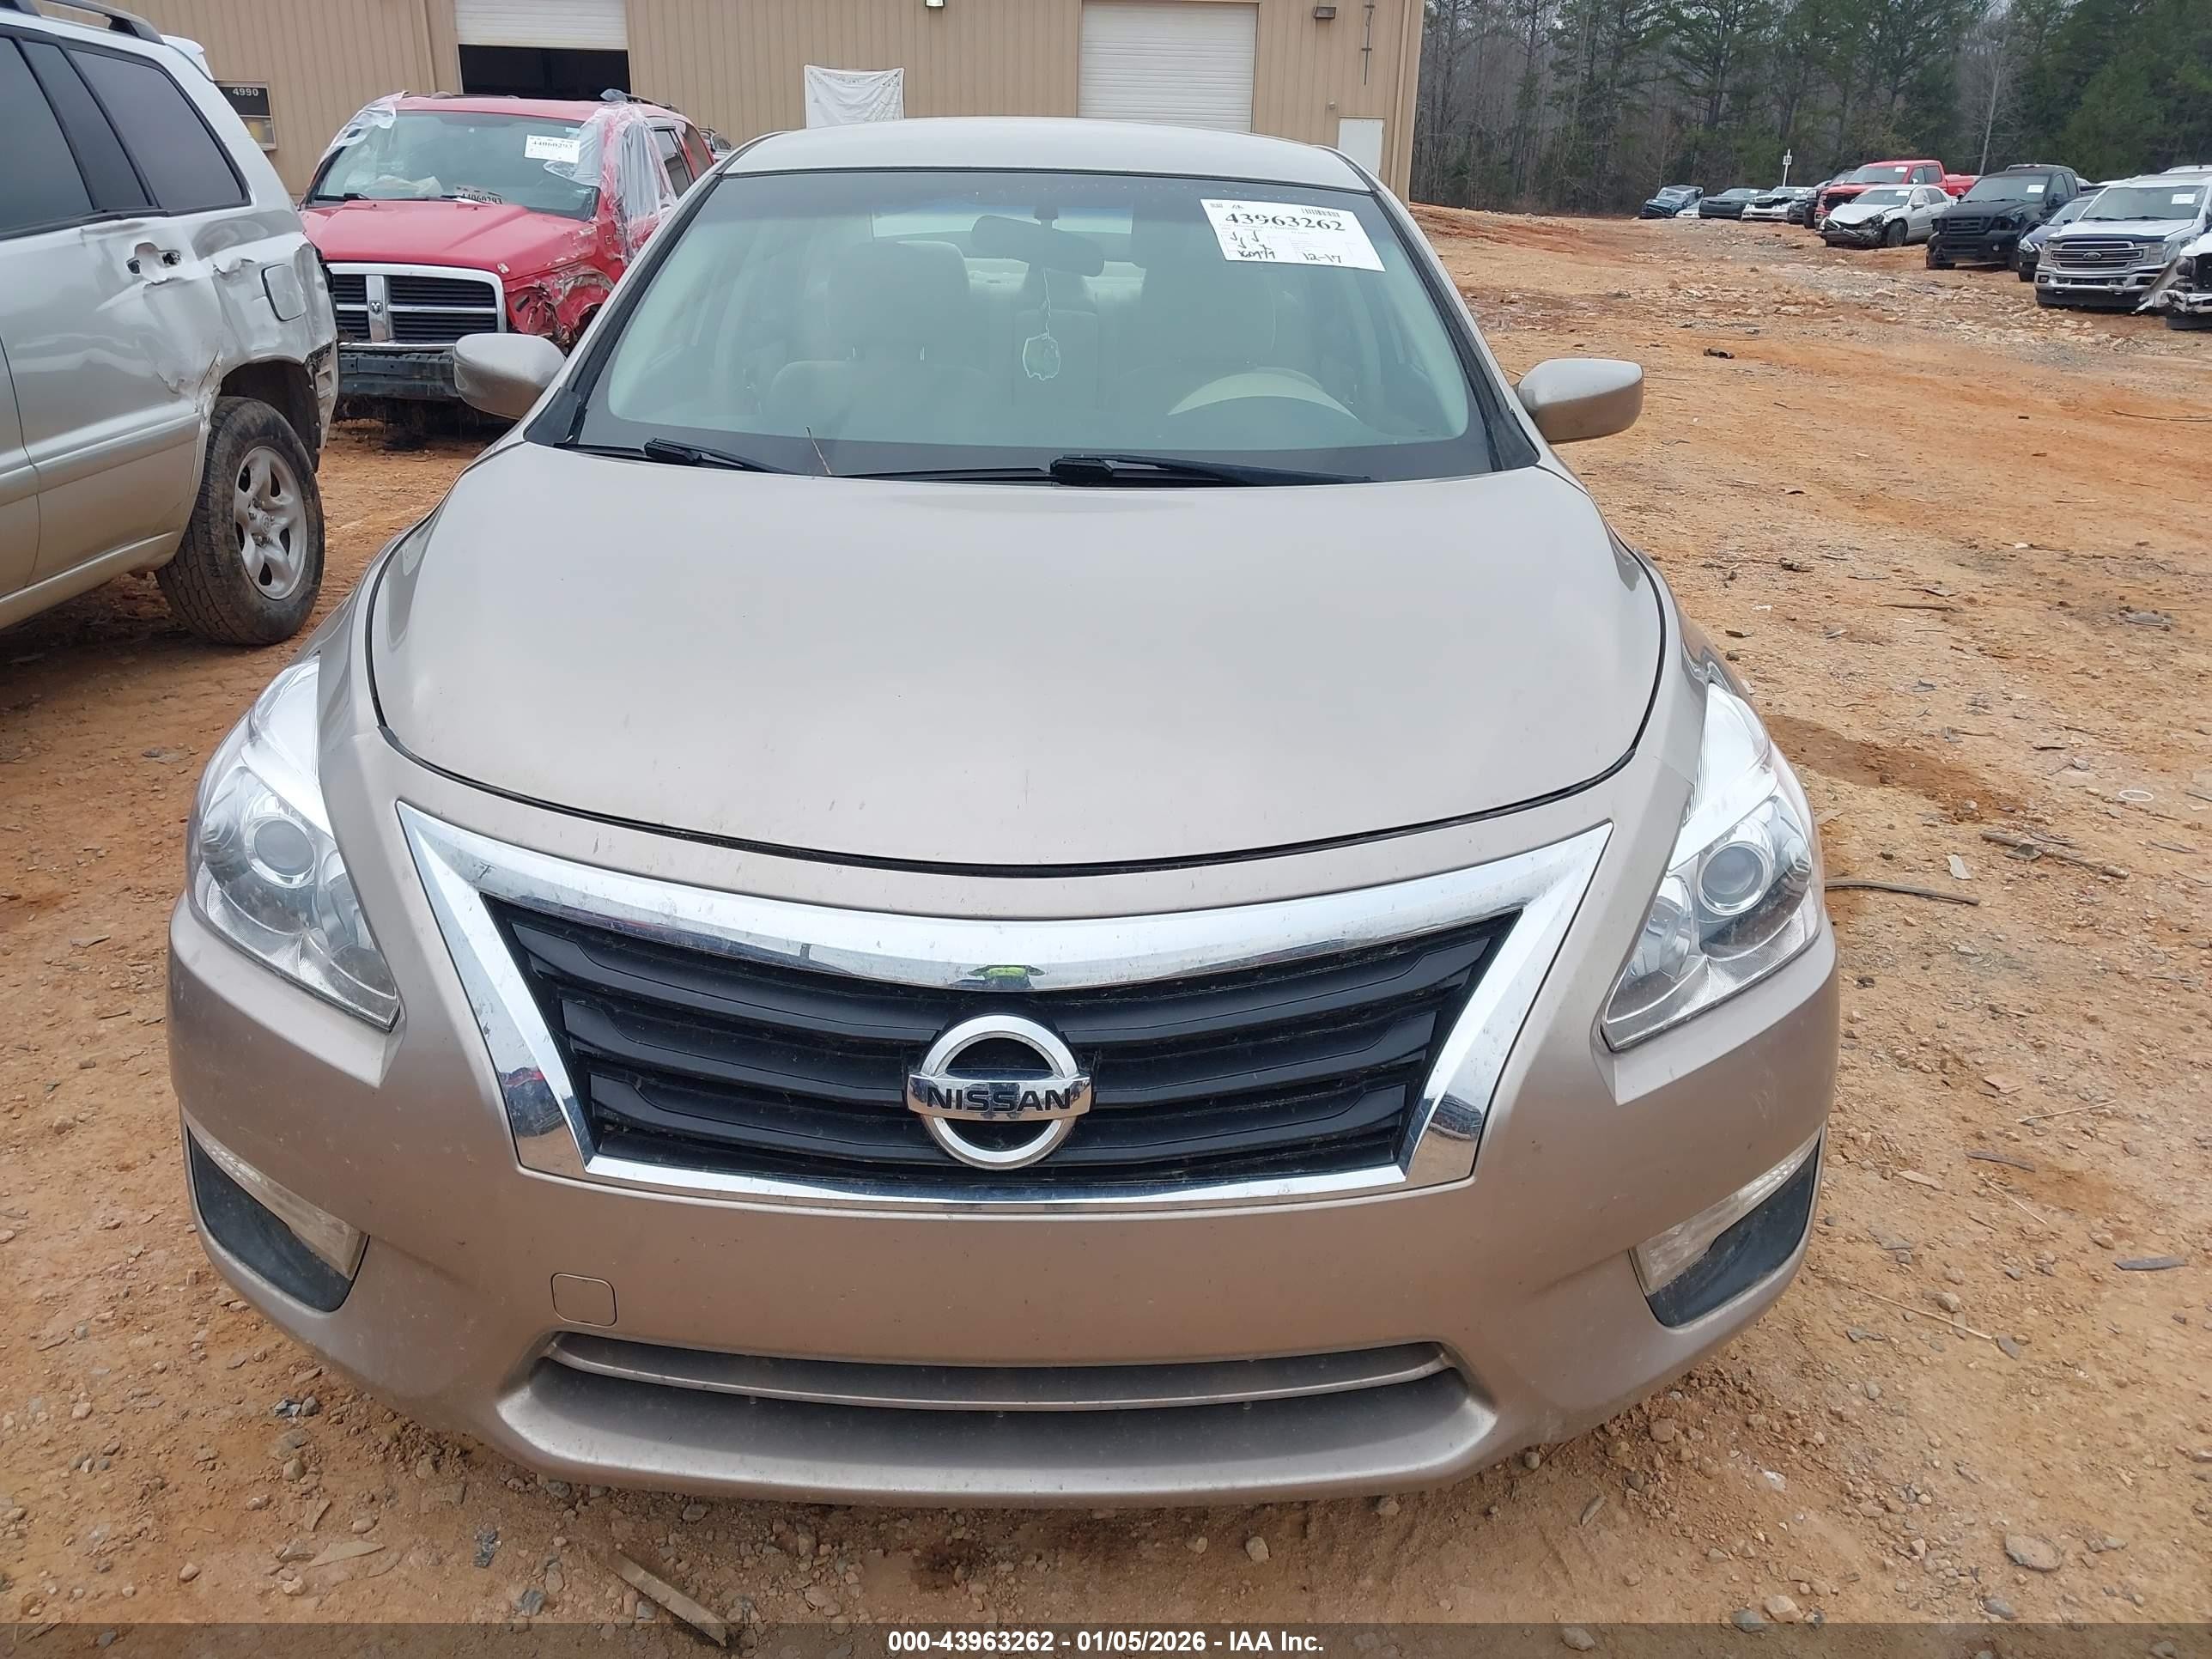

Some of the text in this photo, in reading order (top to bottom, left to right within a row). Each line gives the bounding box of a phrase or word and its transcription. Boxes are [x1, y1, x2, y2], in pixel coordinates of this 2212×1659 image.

[233, 88, 259, 96] 4990
[1225, 213, 1346, 231] 43963262
[927, 1086, 1071, 1112] NISSAN
